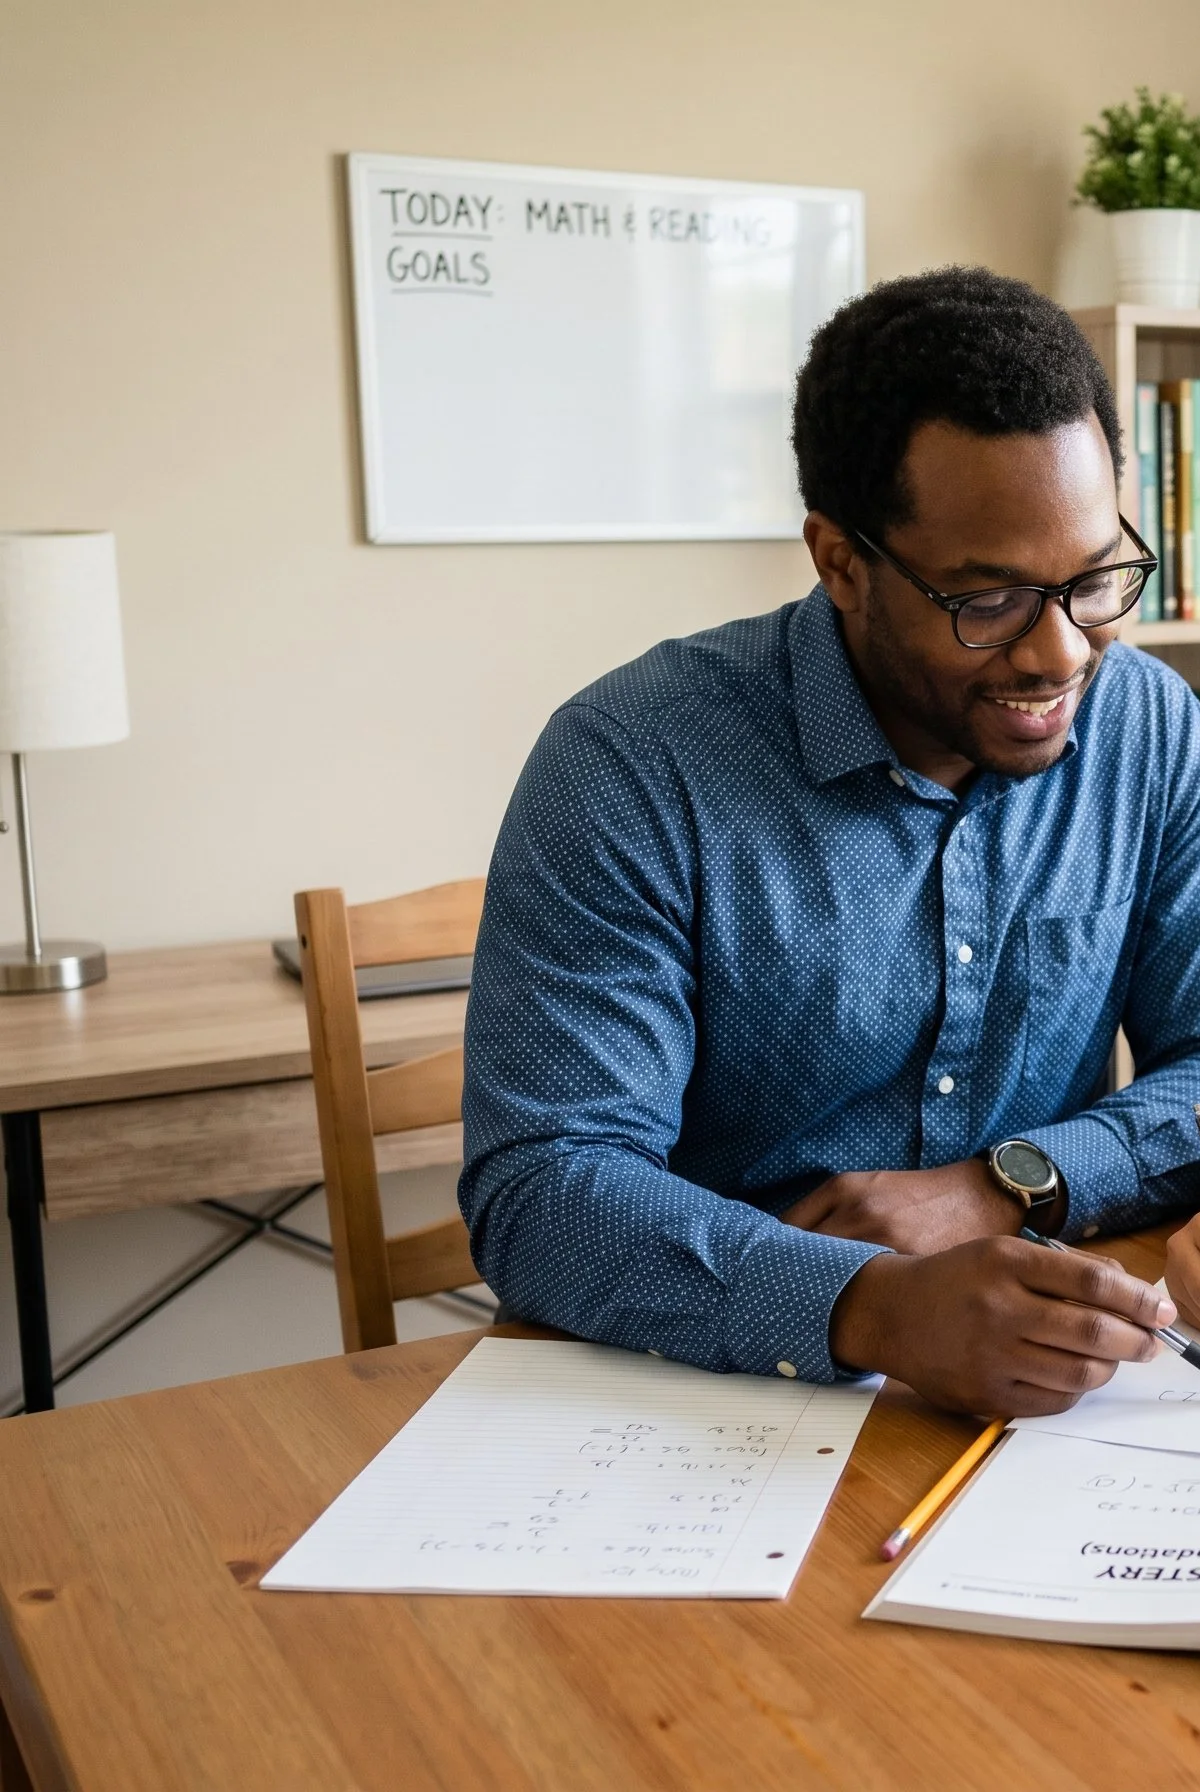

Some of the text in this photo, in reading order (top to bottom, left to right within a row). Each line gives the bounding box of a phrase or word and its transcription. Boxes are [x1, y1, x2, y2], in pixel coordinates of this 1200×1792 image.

[380, 188, 505, 230] TODAY:
[525, 200, 611, 238] MATH
[650, 207, 772, 246] READING
[386, 246, 491, 286] GOALS
